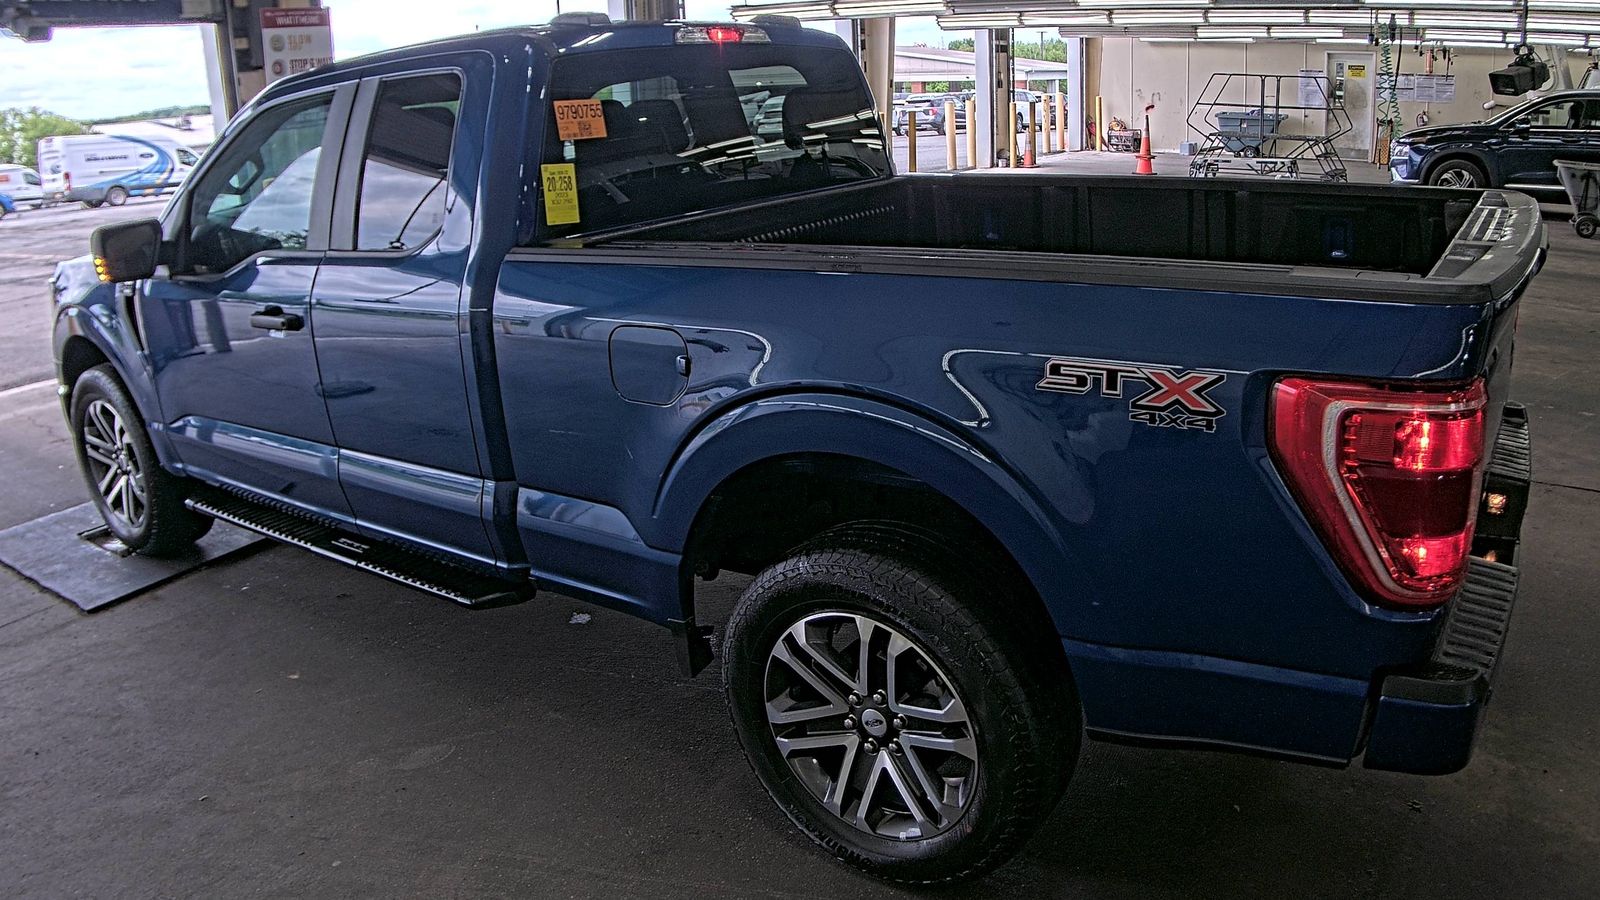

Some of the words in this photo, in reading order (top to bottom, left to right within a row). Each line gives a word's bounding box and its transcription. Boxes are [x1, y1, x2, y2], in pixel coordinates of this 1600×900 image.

[289, 58, 308, 70] STOP
[557, 103, 602, 120] 9790755
[1035, 356, 1227, 419] STX
